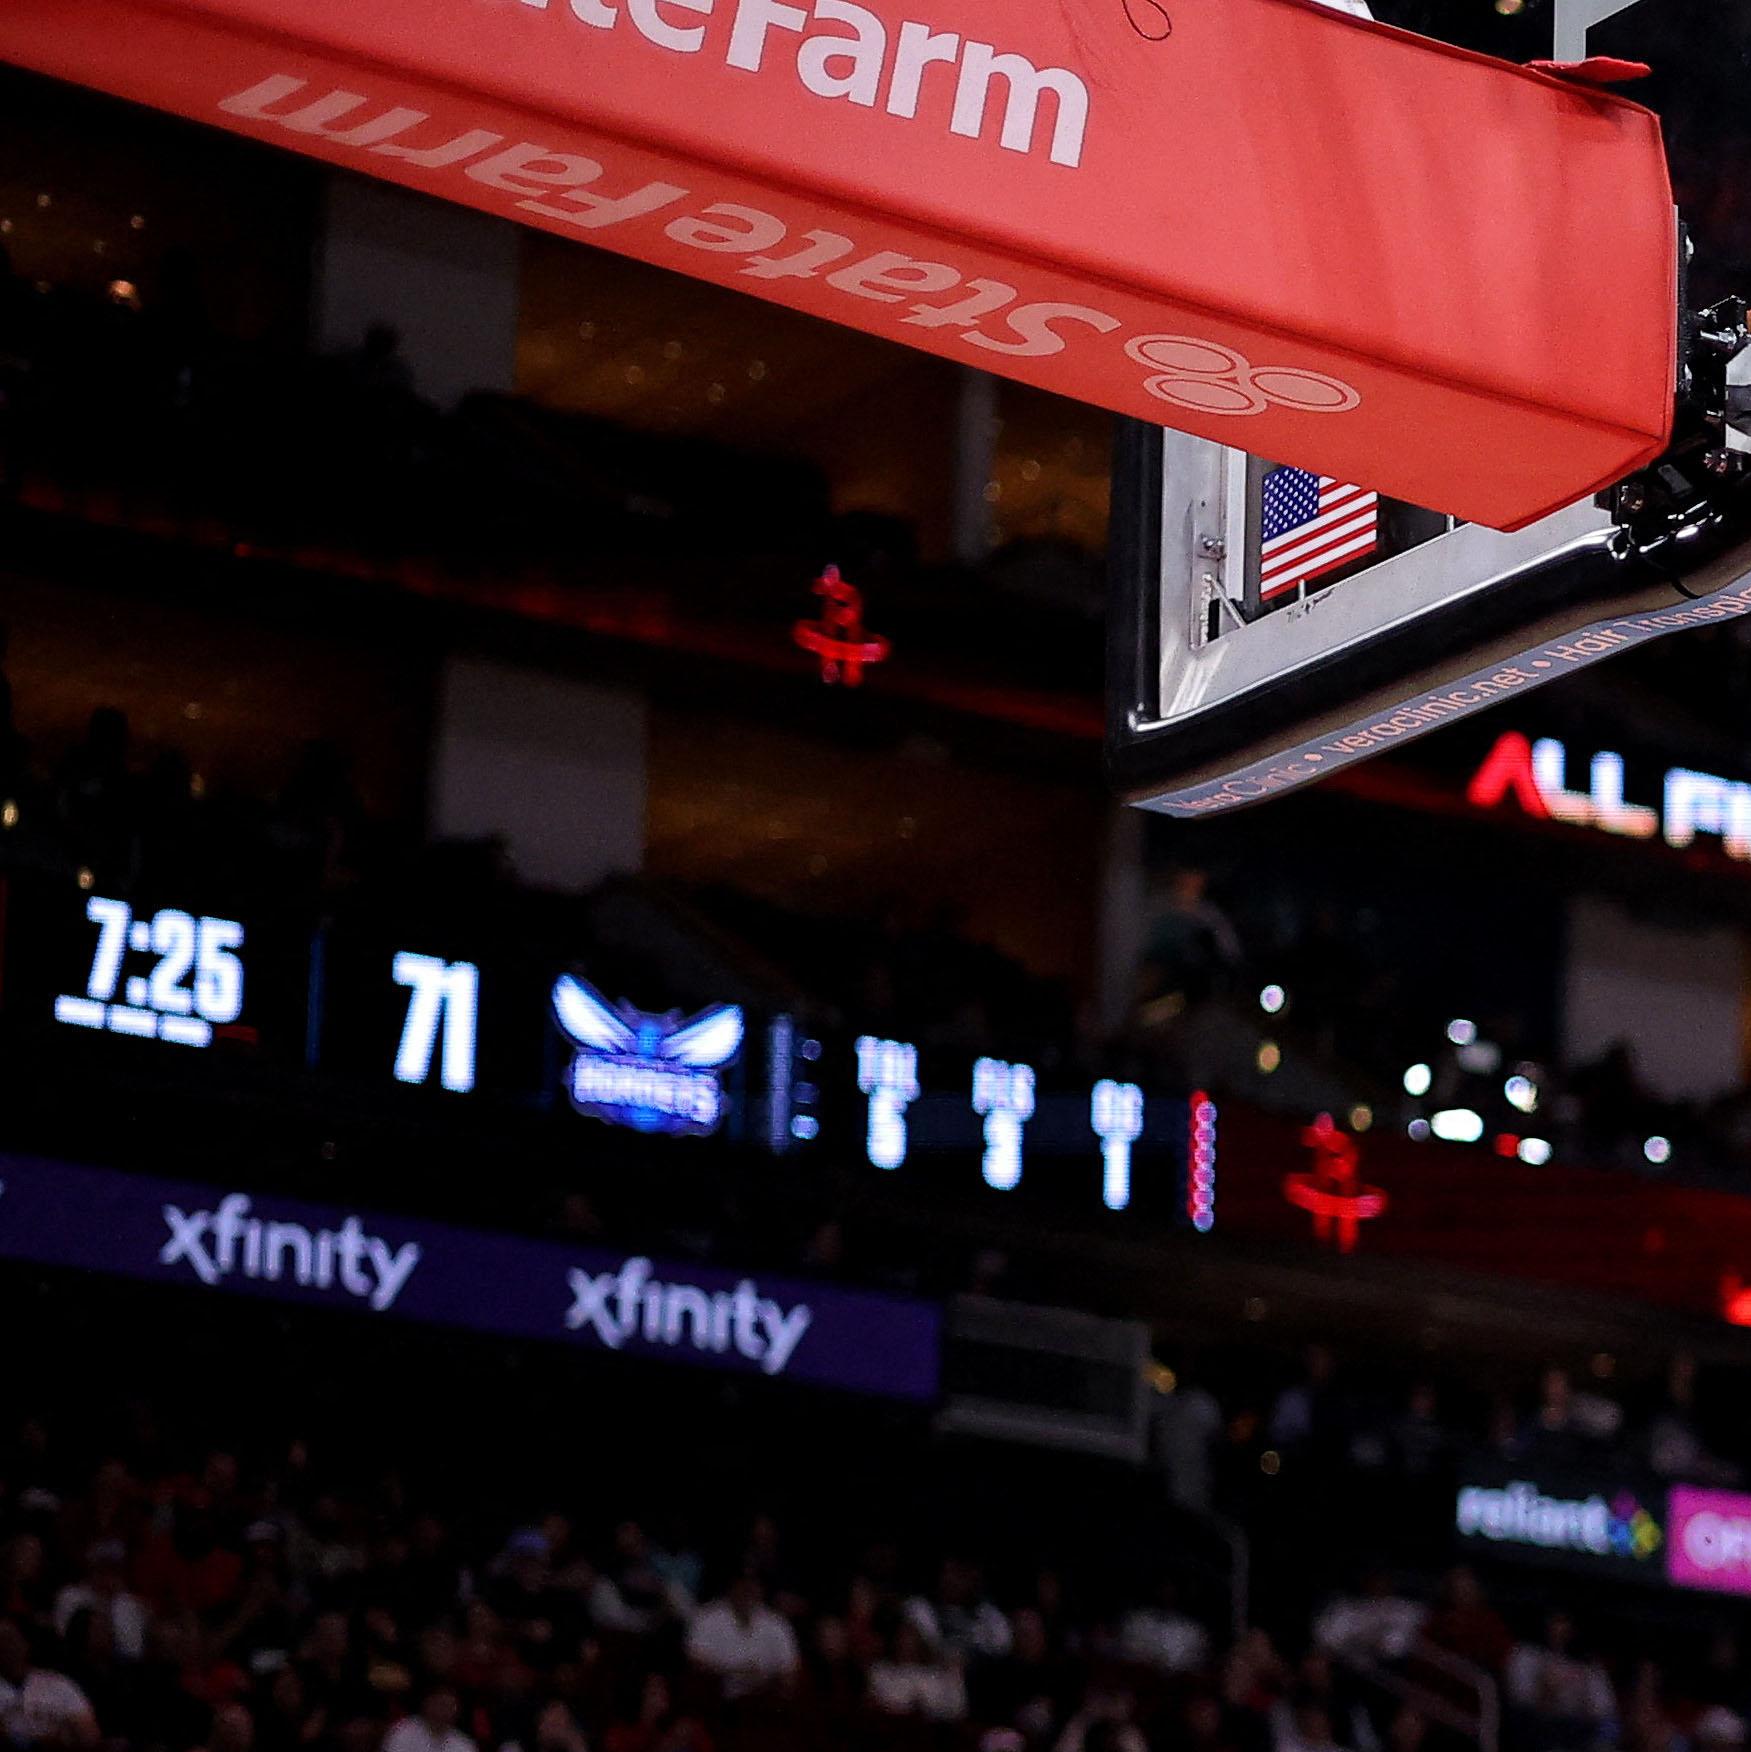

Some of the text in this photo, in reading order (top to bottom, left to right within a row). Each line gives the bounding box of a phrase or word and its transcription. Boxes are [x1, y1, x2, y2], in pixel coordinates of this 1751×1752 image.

[1321, 664, 1538, 756] veraclinic.net
[1544, 624, 1630, 664] Hair
[1466, 730, 1658, 839] ALL
[86, 896, 245, 1024] 7:25
[392, 951, 480, 1094] 71
[160, 1193, 422, 1311] xfinity
[566, 1256, 811, 1376] xfinity
